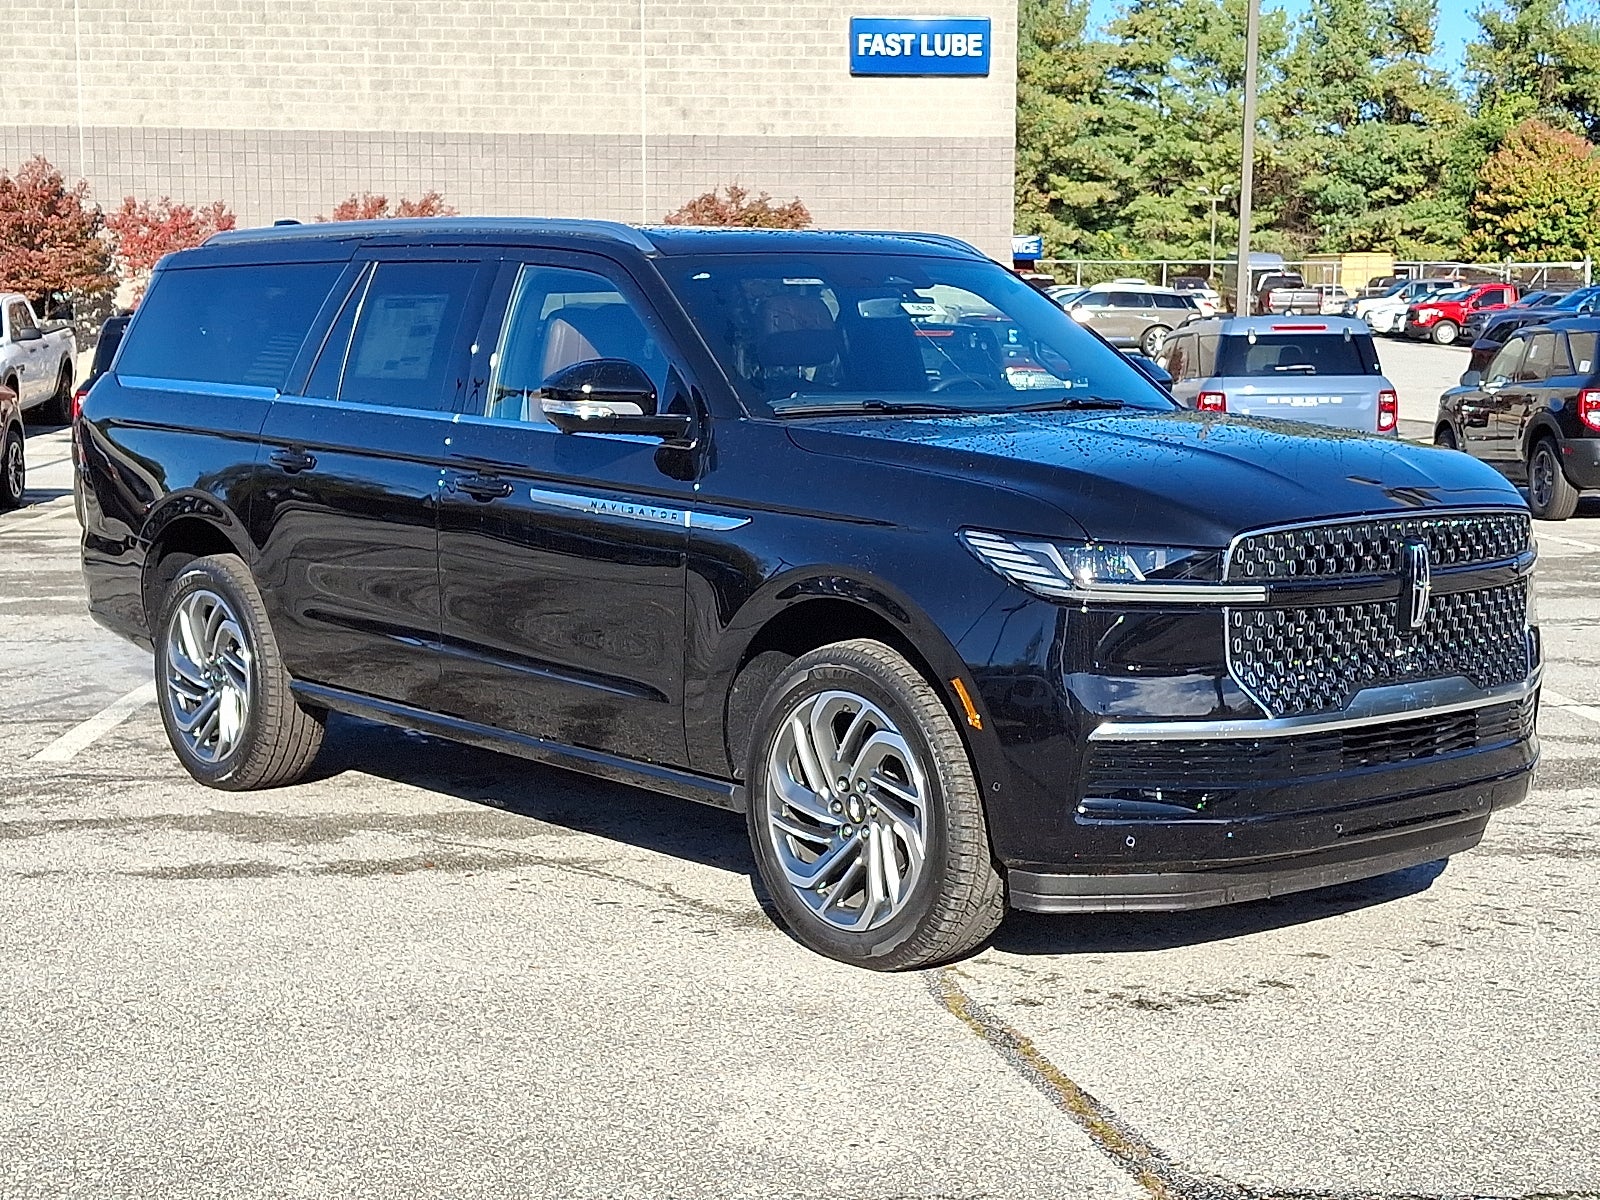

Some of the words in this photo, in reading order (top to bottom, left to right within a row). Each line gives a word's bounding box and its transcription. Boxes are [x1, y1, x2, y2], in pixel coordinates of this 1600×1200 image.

[858, 33, 916, 56] FAST
[920, 33, 983, 57] LUBE
[590, 500, 678, 520] NAVIGATOR
